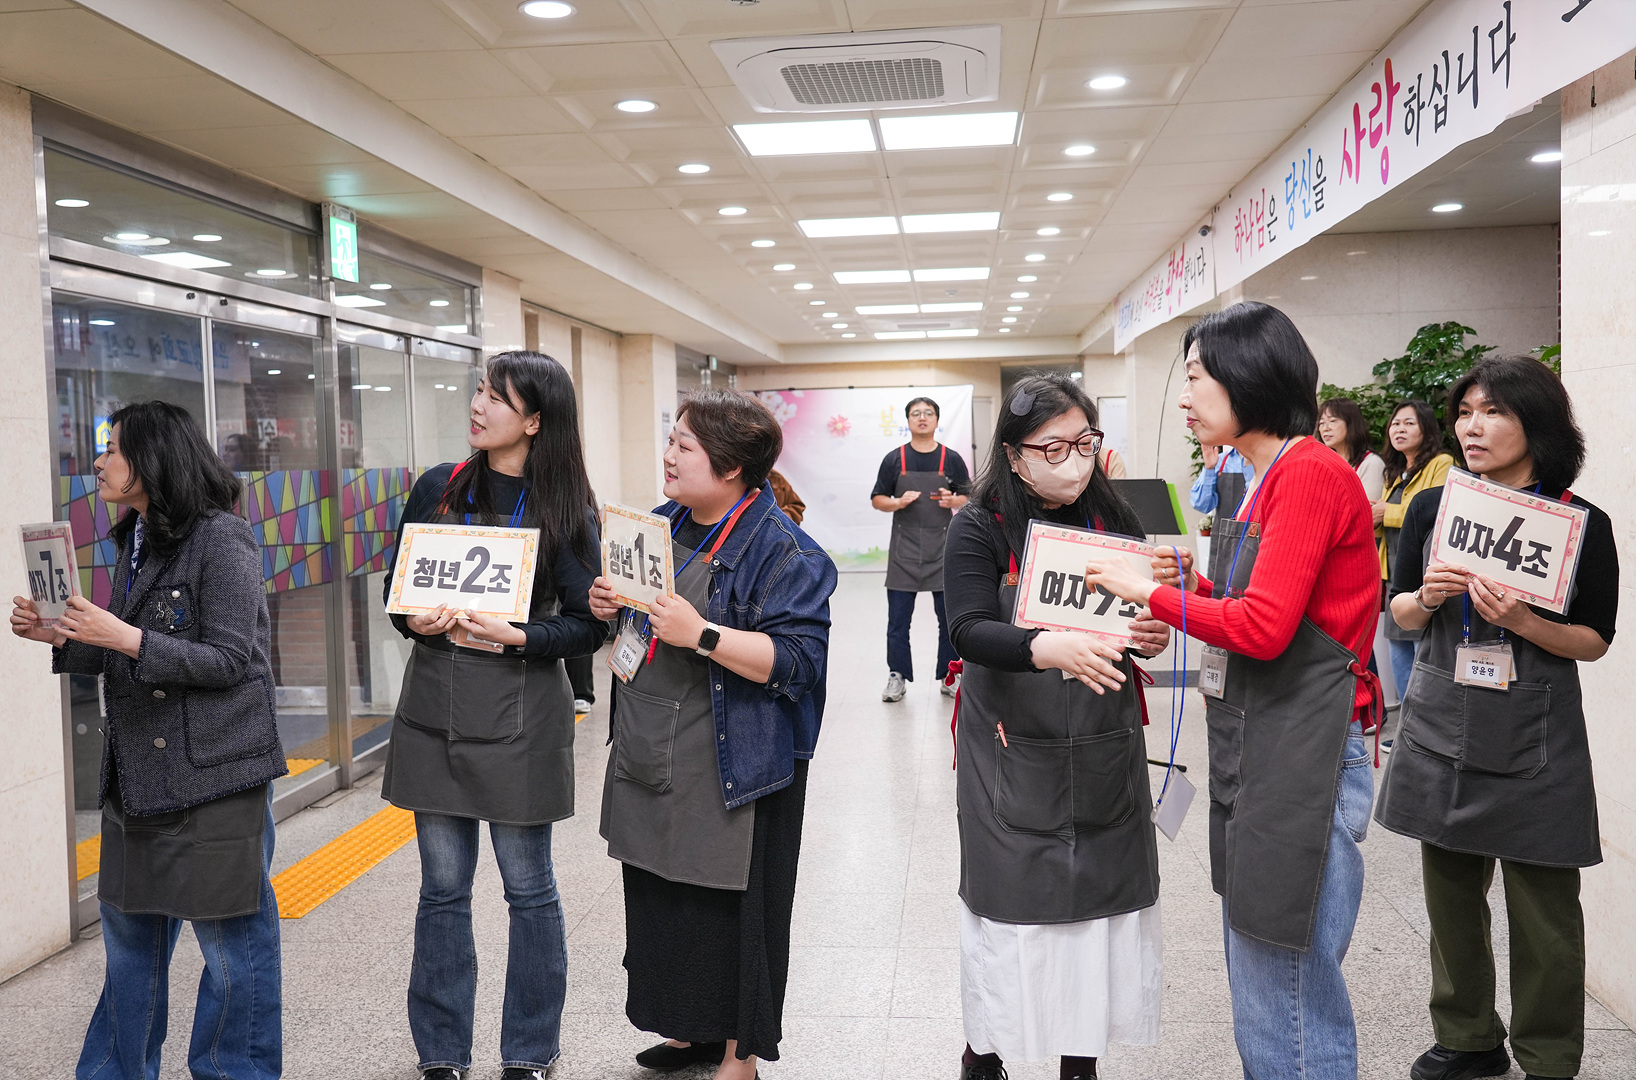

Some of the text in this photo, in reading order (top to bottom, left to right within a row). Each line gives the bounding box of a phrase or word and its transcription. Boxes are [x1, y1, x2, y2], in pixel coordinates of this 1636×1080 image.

[1234, 0, 1517, 264] 하나님은 당신을 사랑하십니다
[1165, 241, 1207, 316] 환영합니다
[28, 549, 70, 604] 여자7조
[412, 545, 513, 595] 청년2조
[609, 532, 663, 590] 청년1조
[1447, 515, 1553, 580] 여자4조
